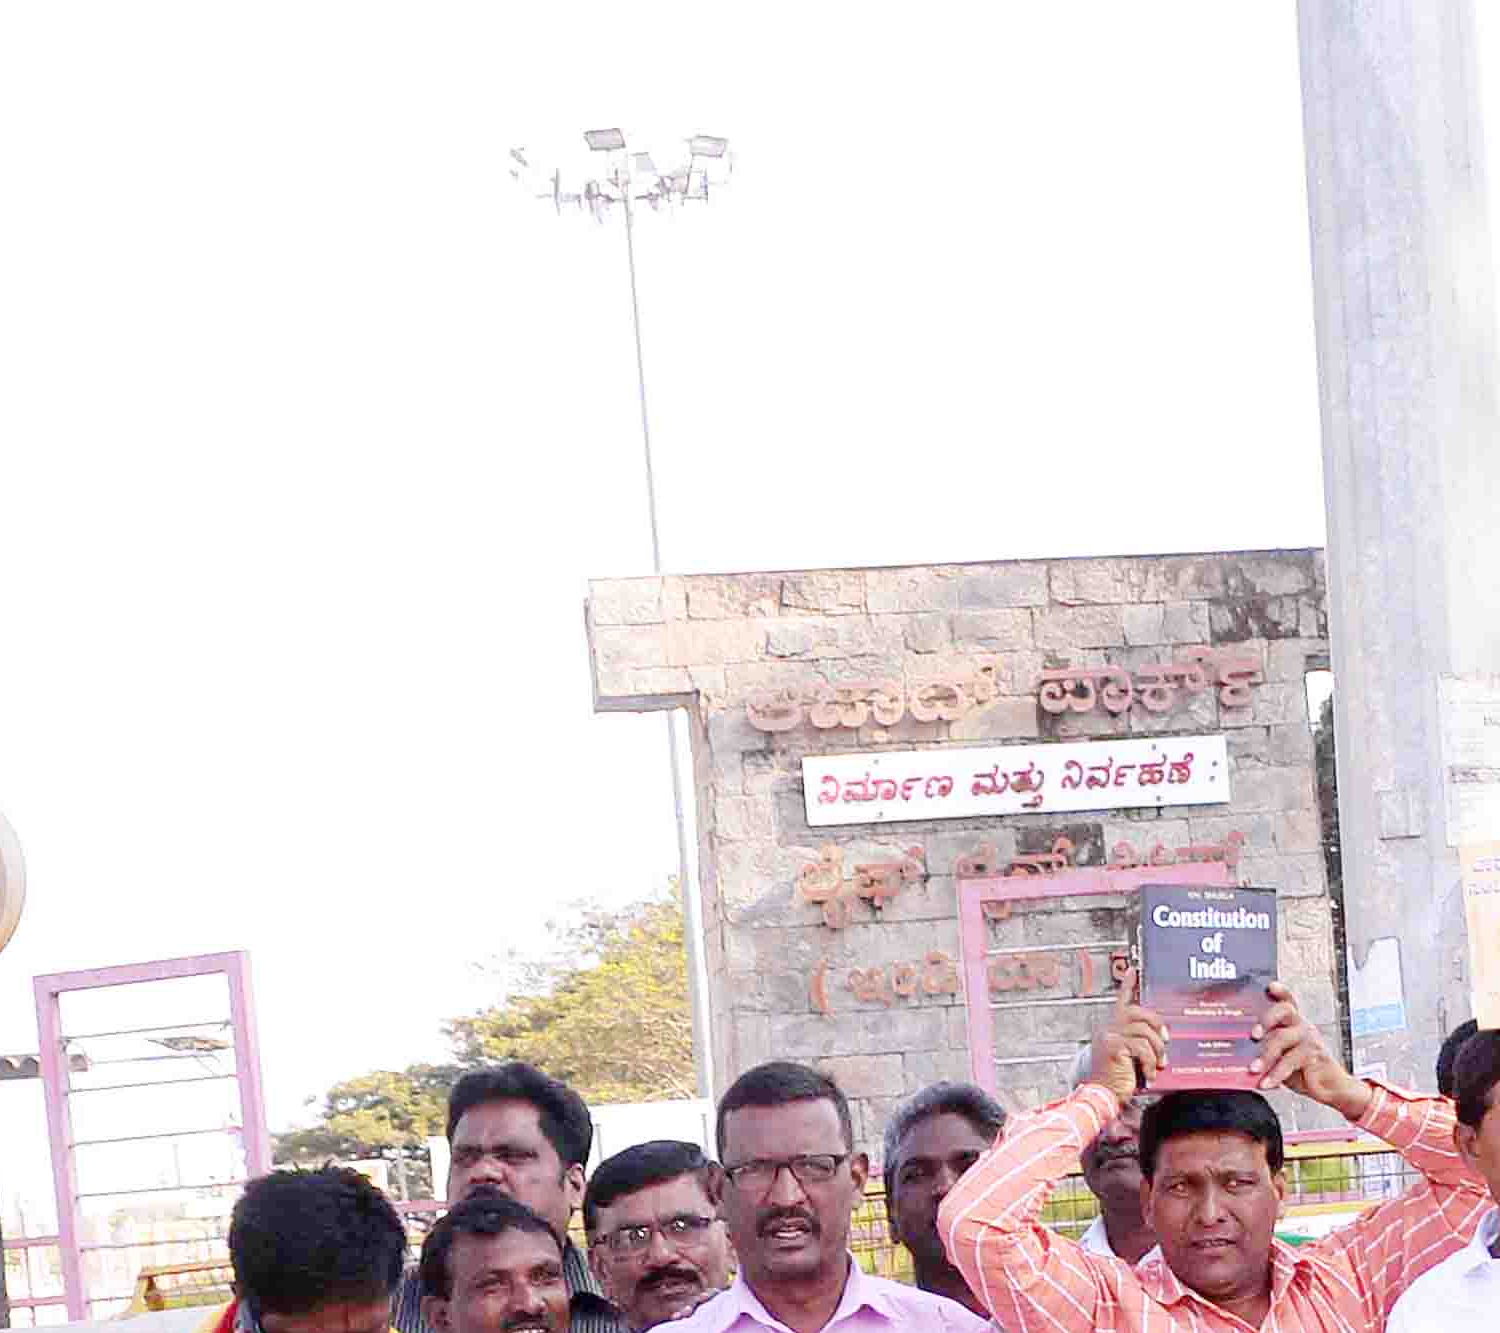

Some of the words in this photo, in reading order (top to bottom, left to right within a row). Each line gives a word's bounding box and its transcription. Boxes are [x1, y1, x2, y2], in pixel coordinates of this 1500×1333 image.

[971, 761, 1045, 809] ಮತ್ತು
[1152, 904, 1271, 930] Constitution
[1201, 932, 1226, 954] of
[1188, 956, 1238, 980] India
